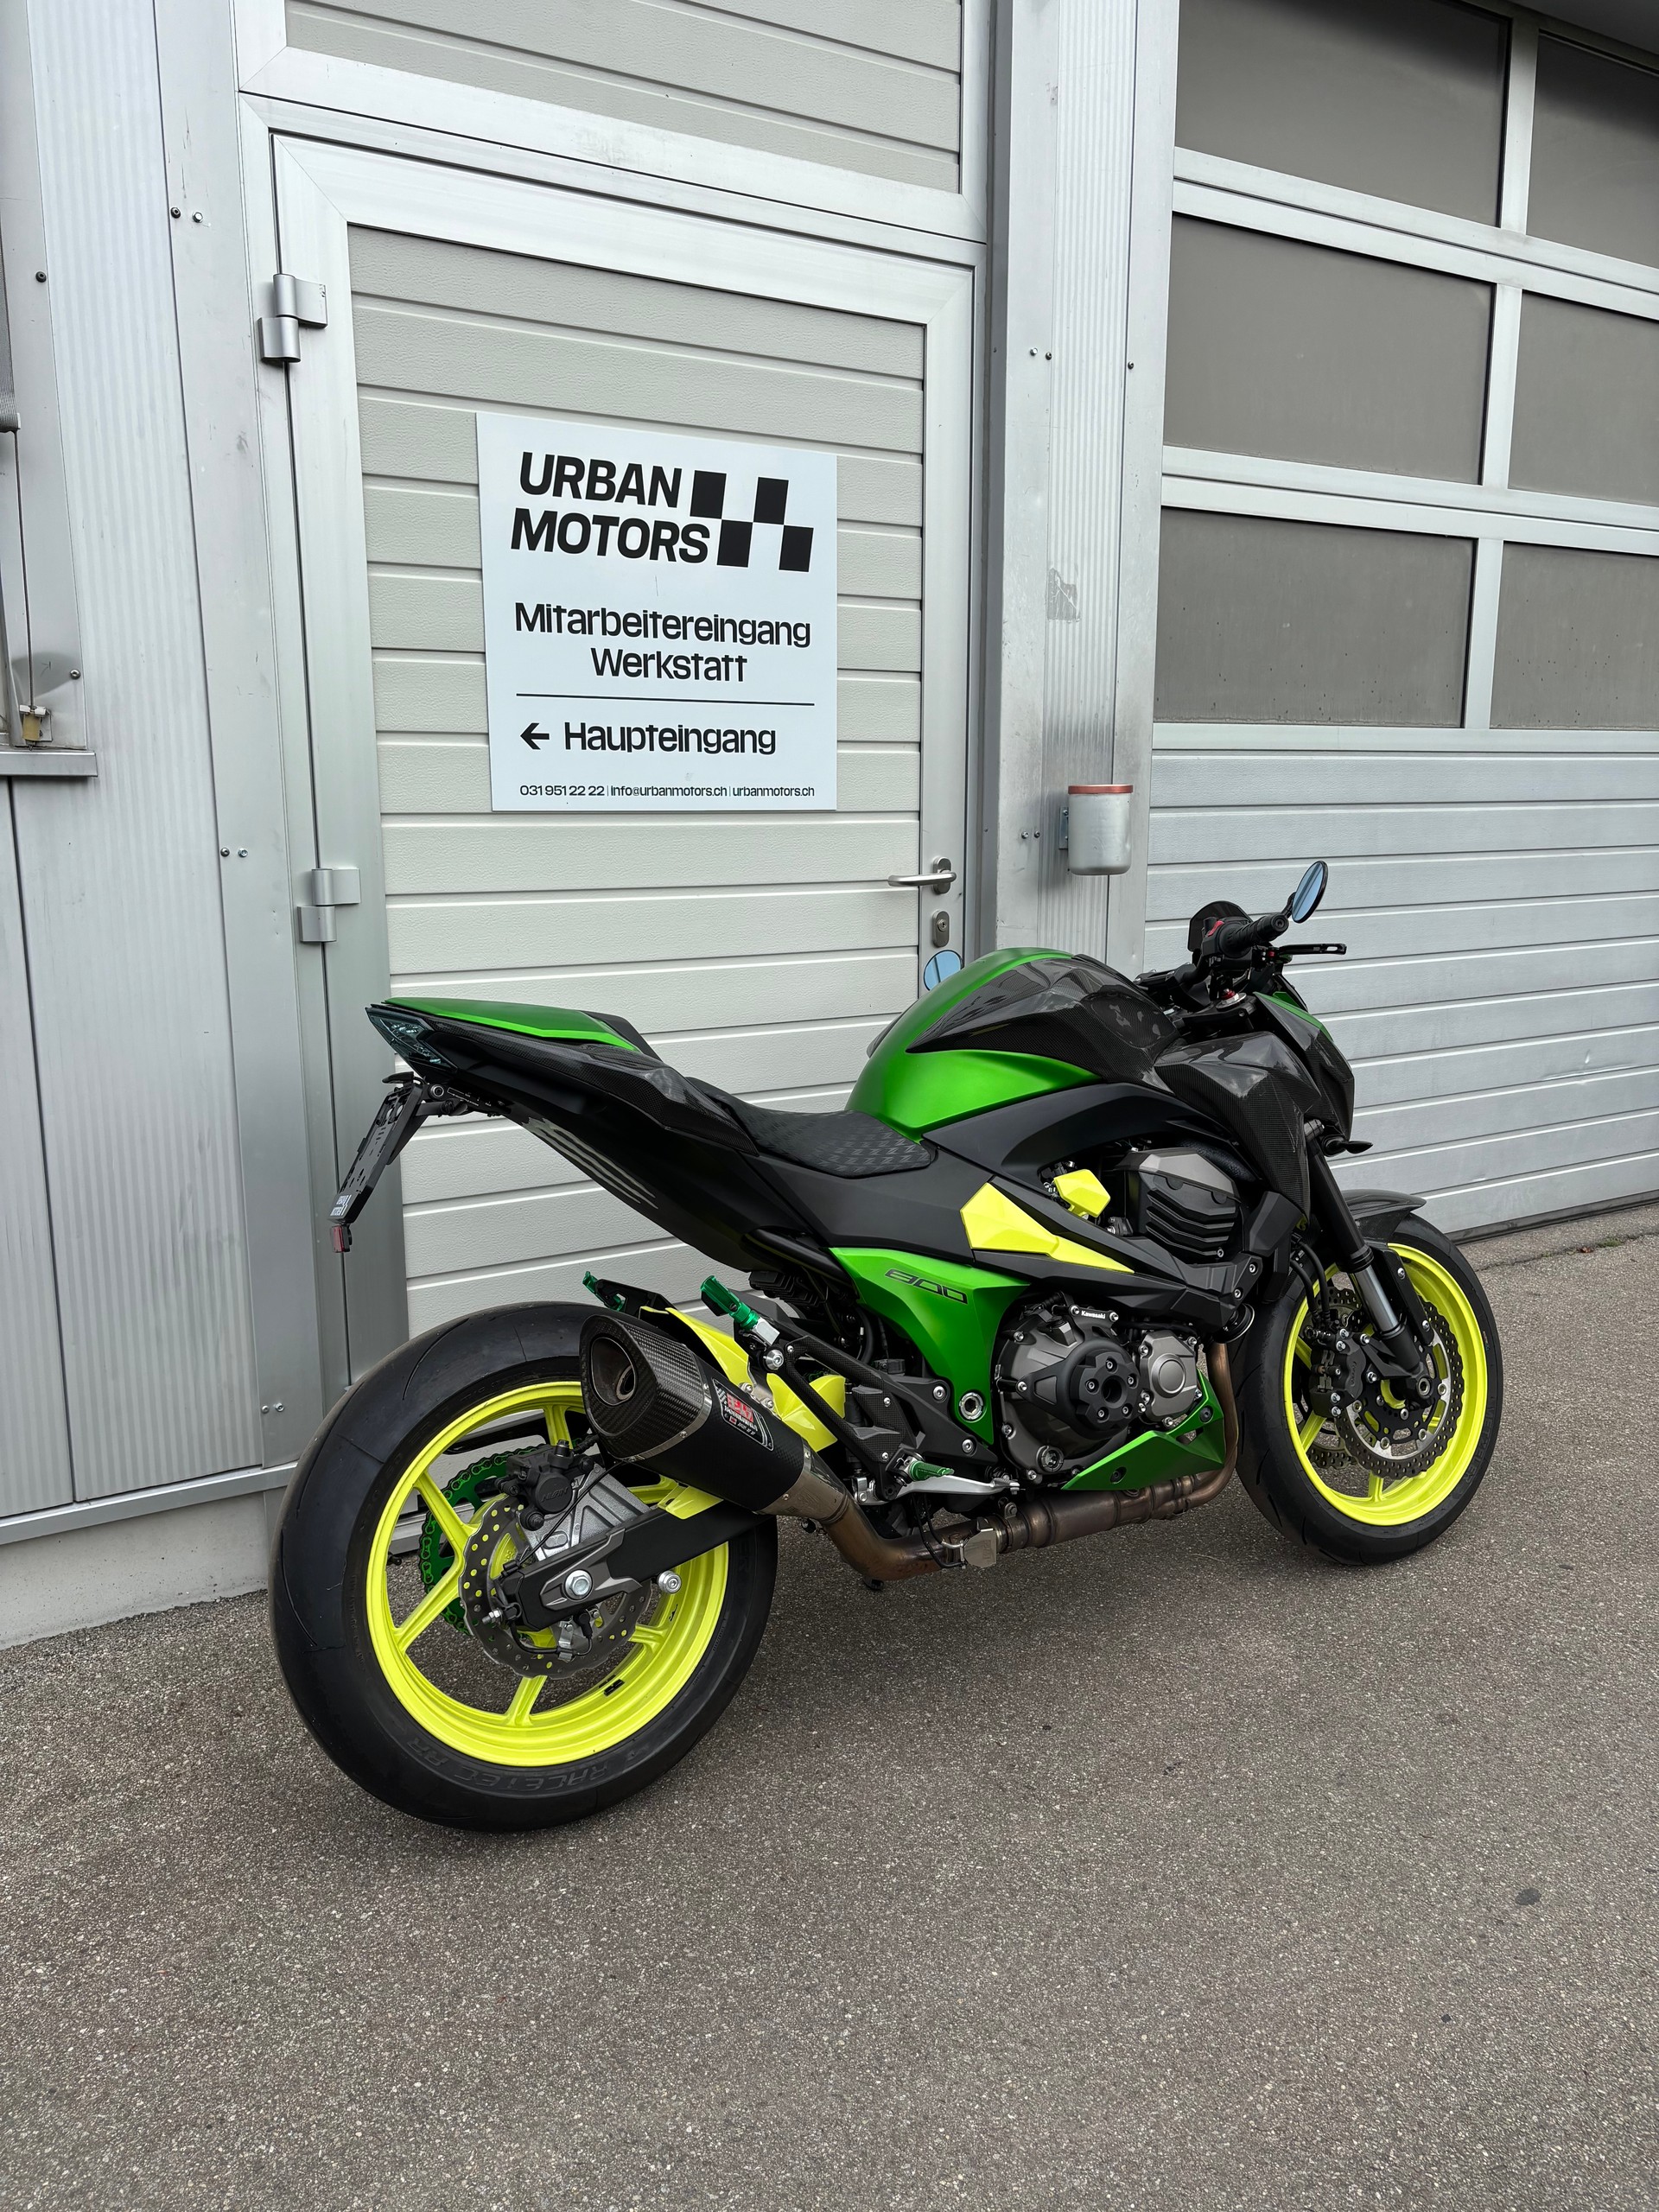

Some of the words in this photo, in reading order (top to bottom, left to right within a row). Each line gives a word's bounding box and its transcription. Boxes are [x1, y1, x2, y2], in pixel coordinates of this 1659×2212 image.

[519, 451, 683, 509] URBAN
[510, 507, 710, 564] MOTORS
[515, 601, 810, 648] Mitarbeitereingang
[590, 647, 748, 683] Werkstatt
[564, 721, 776, 755] Haupteingang
[519, 785, 543, 797] 031
[544, 785, 567, 797] 951
[569, 785, 587, 797] 22
[588, 785, 606, 797] 22
[732, 786, 815, 797] urbanmotors.ch
[884, 1268, 968, 1305] 800
[453, 1760, 609, 1792] RACETEC
